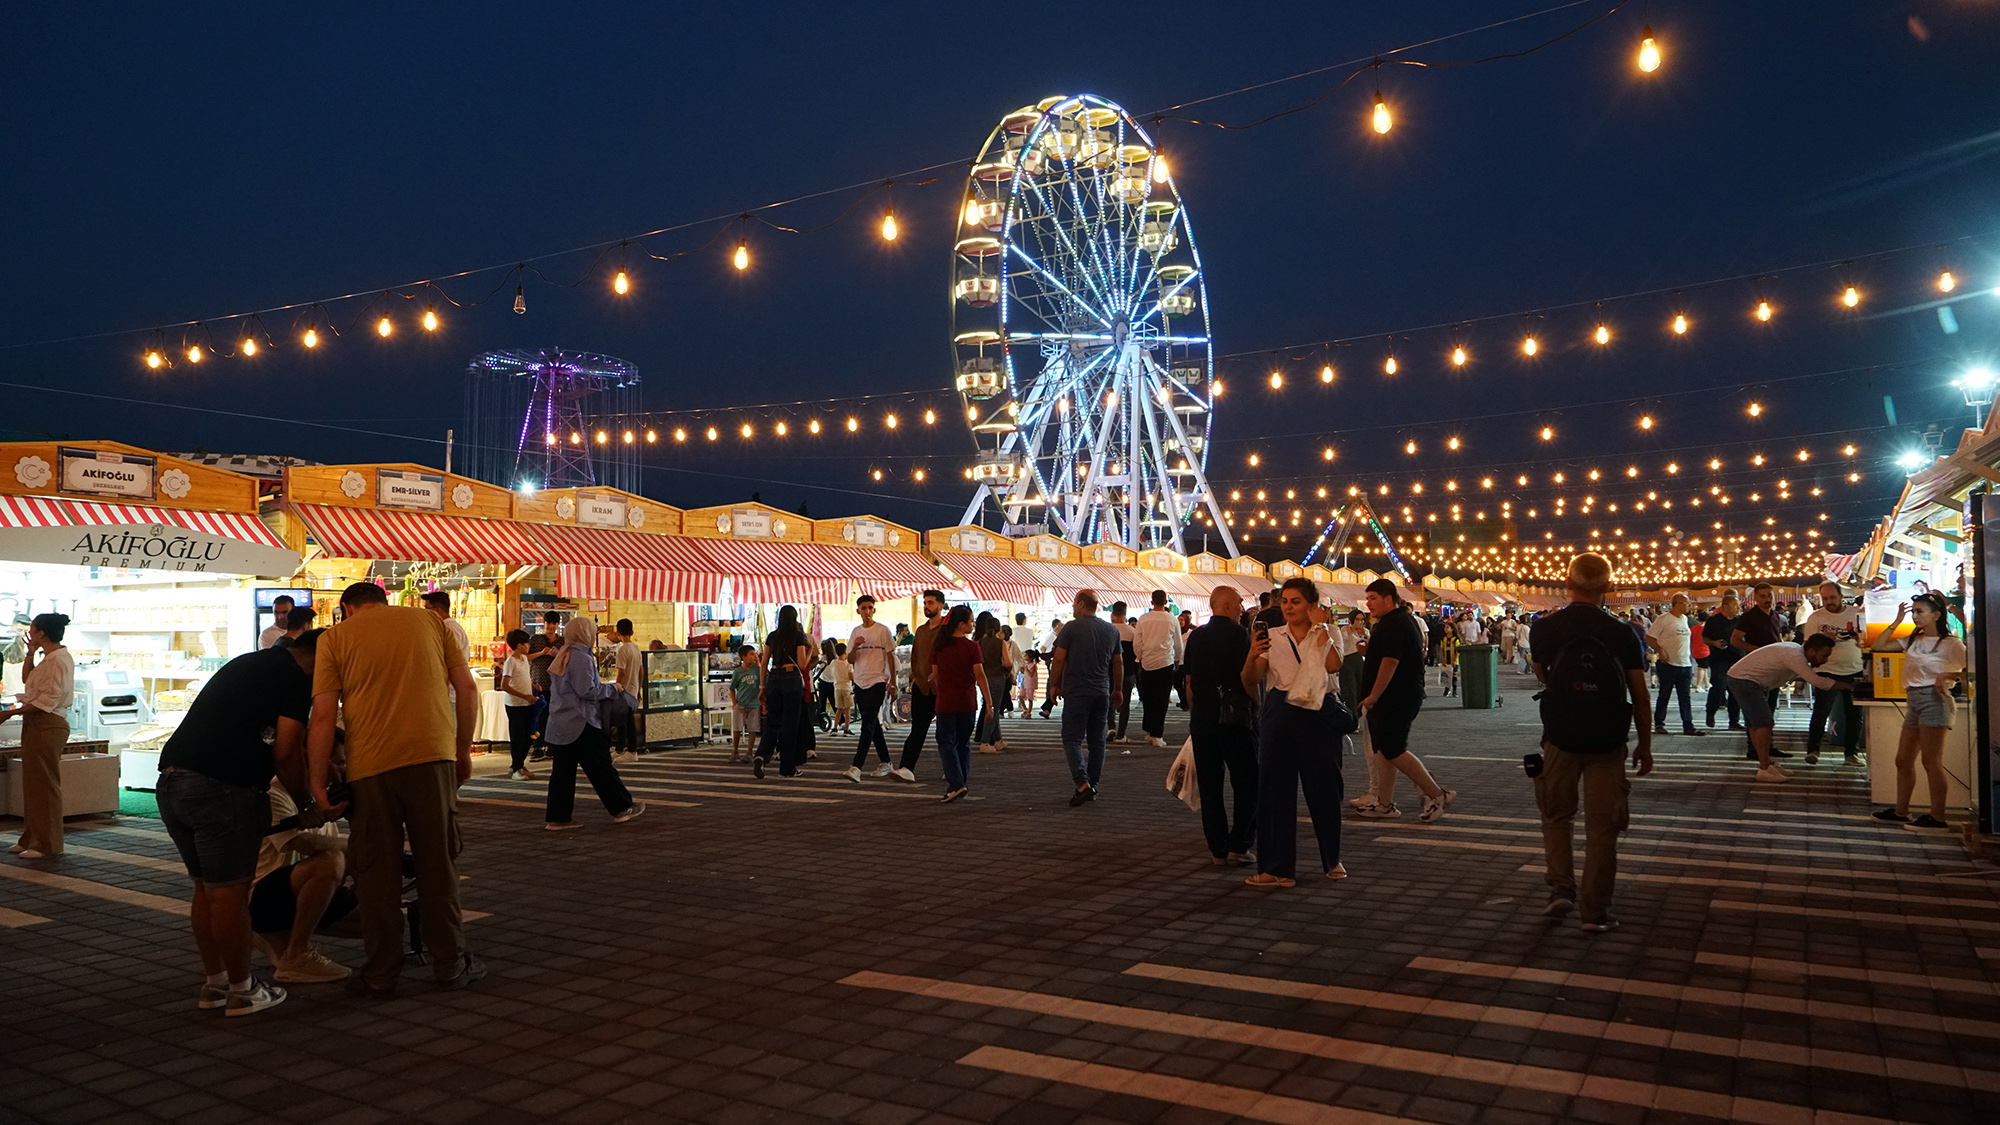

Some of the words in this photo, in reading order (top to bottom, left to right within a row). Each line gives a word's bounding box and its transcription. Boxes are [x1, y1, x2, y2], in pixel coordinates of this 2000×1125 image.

[82, 469, 135, 482] AKİFOĞLU
[391, 486, 431, 496] EMR-SİLVER
[591, 505, 613, 515] İKRAM
[71, 531, 225, 561] AKİFOĞLU
[80, 556, 207, 572] PREMIUM
